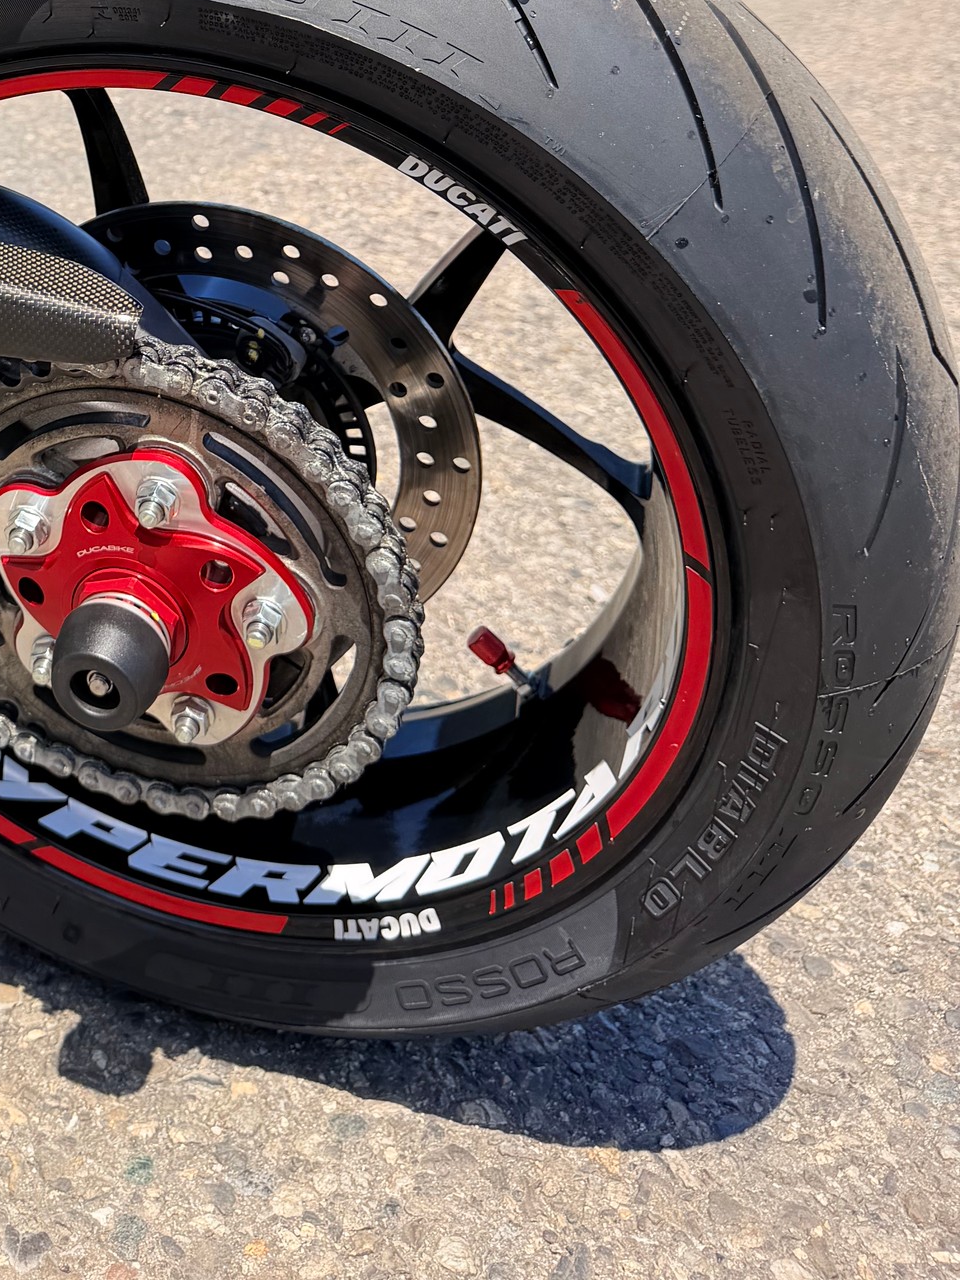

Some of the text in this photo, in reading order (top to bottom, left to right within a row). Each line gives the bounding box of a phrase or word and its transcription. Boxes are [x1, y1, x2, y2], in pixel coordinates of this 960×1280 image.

[397, 154, 528, 247] DUCATI
[721, 408, 763, 487] TUBELESS
[77, 545, 135, 558] DUCABIKE
[793, 604, 858, 816] ROSSO
[641, 720, 789, 922] DIABLO
[333, 907, 442, 942] DUCATI
[394, 937, 587, 1011] ROSSO
